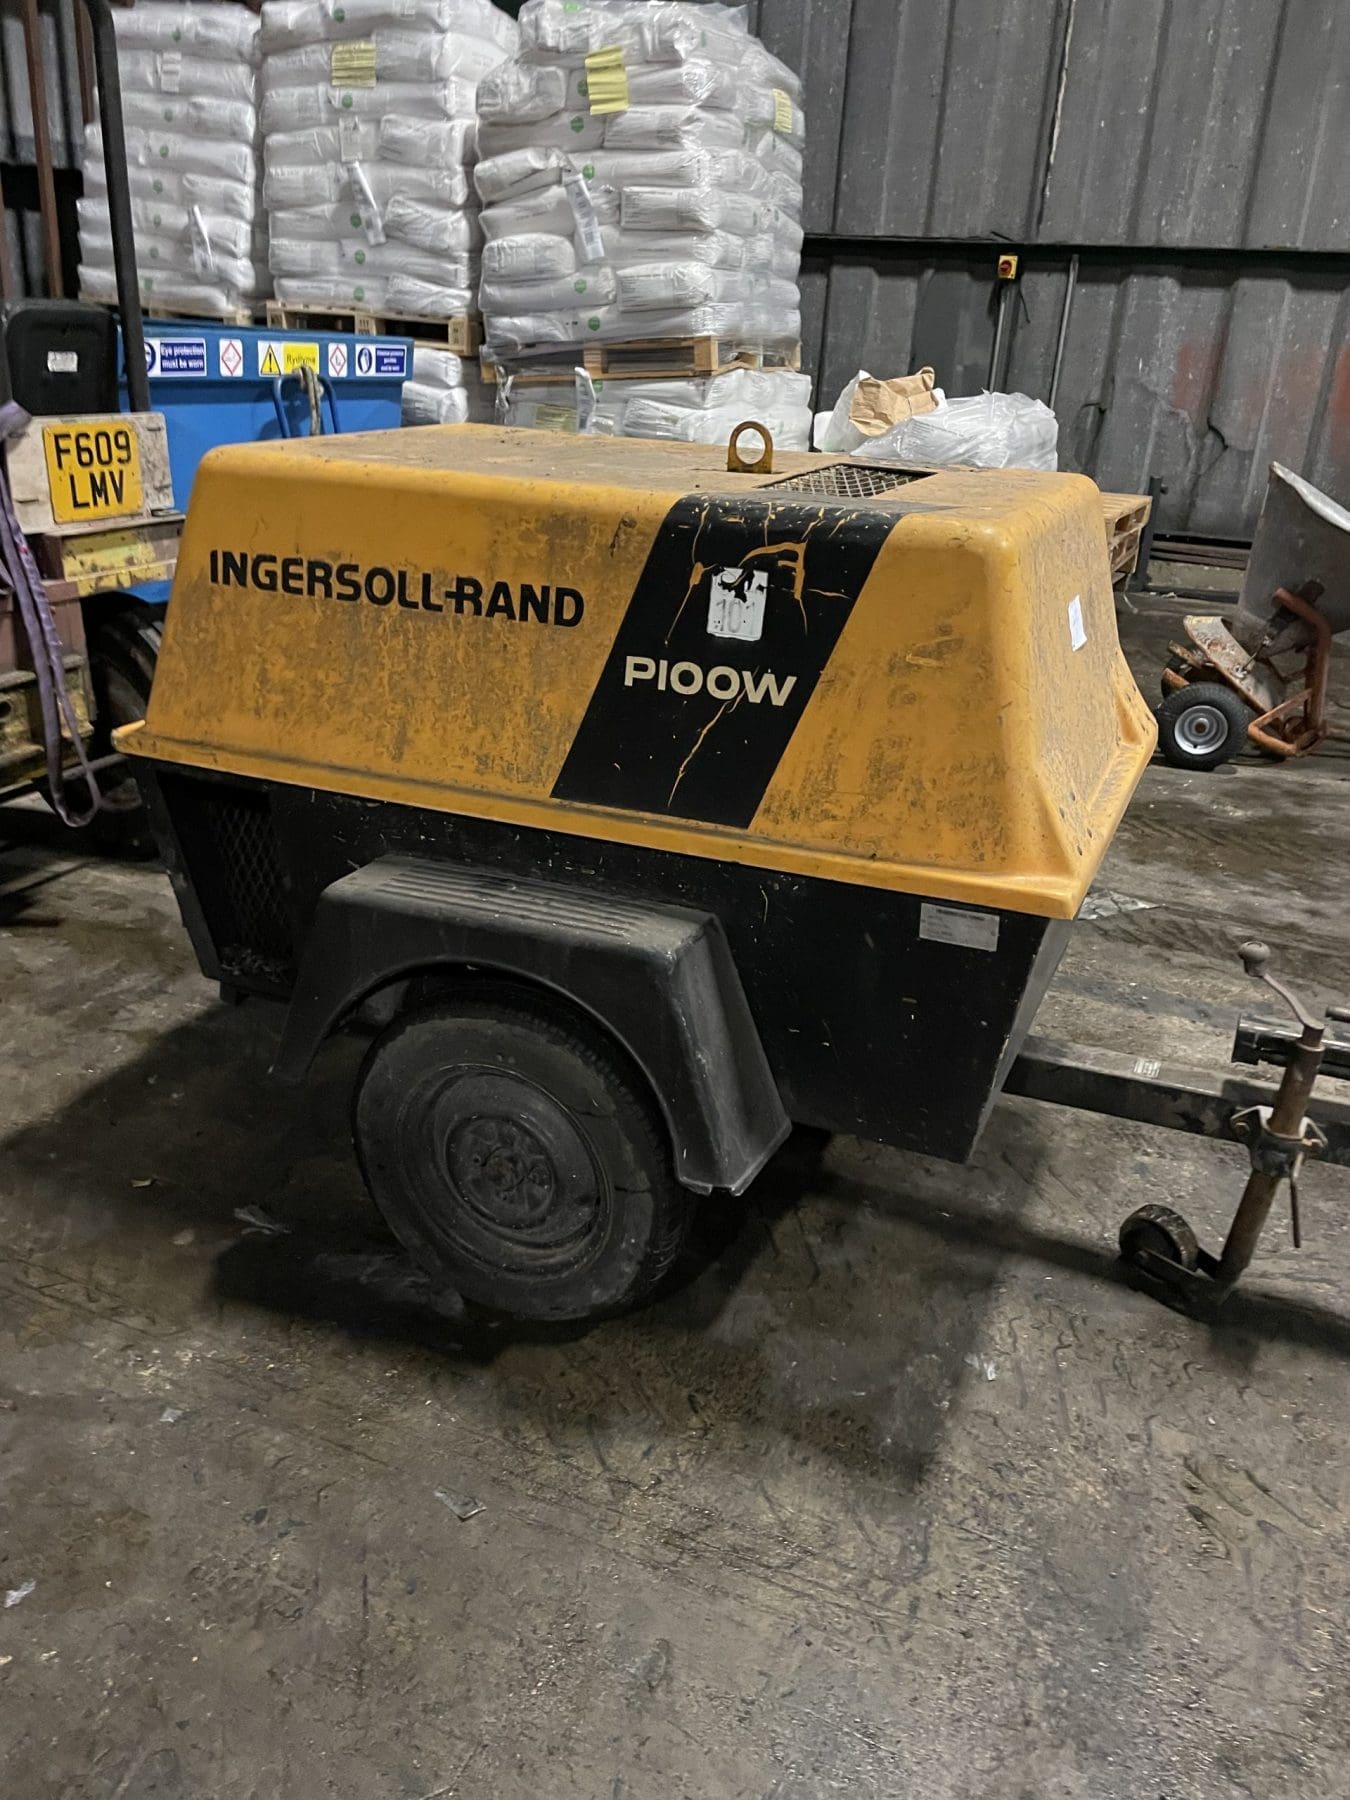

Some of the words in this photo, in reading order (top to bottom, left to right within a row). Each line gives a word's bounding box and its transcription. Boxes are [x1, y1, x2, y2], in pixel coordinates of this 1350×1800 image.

[161, 344, 173, 358] Eye
[173, 345, 204, 357] protection
[162, 358, 178, 369] must
[179, 357, 187, 369] be
[188, 359, 204, 369] worn
[53, 430, 132, 470] F609
[69, 469, 125, 509] LMV
[208, 549, 586, 628] INGERSOLL-RAND
[623, 654, 798, 707] P100W
